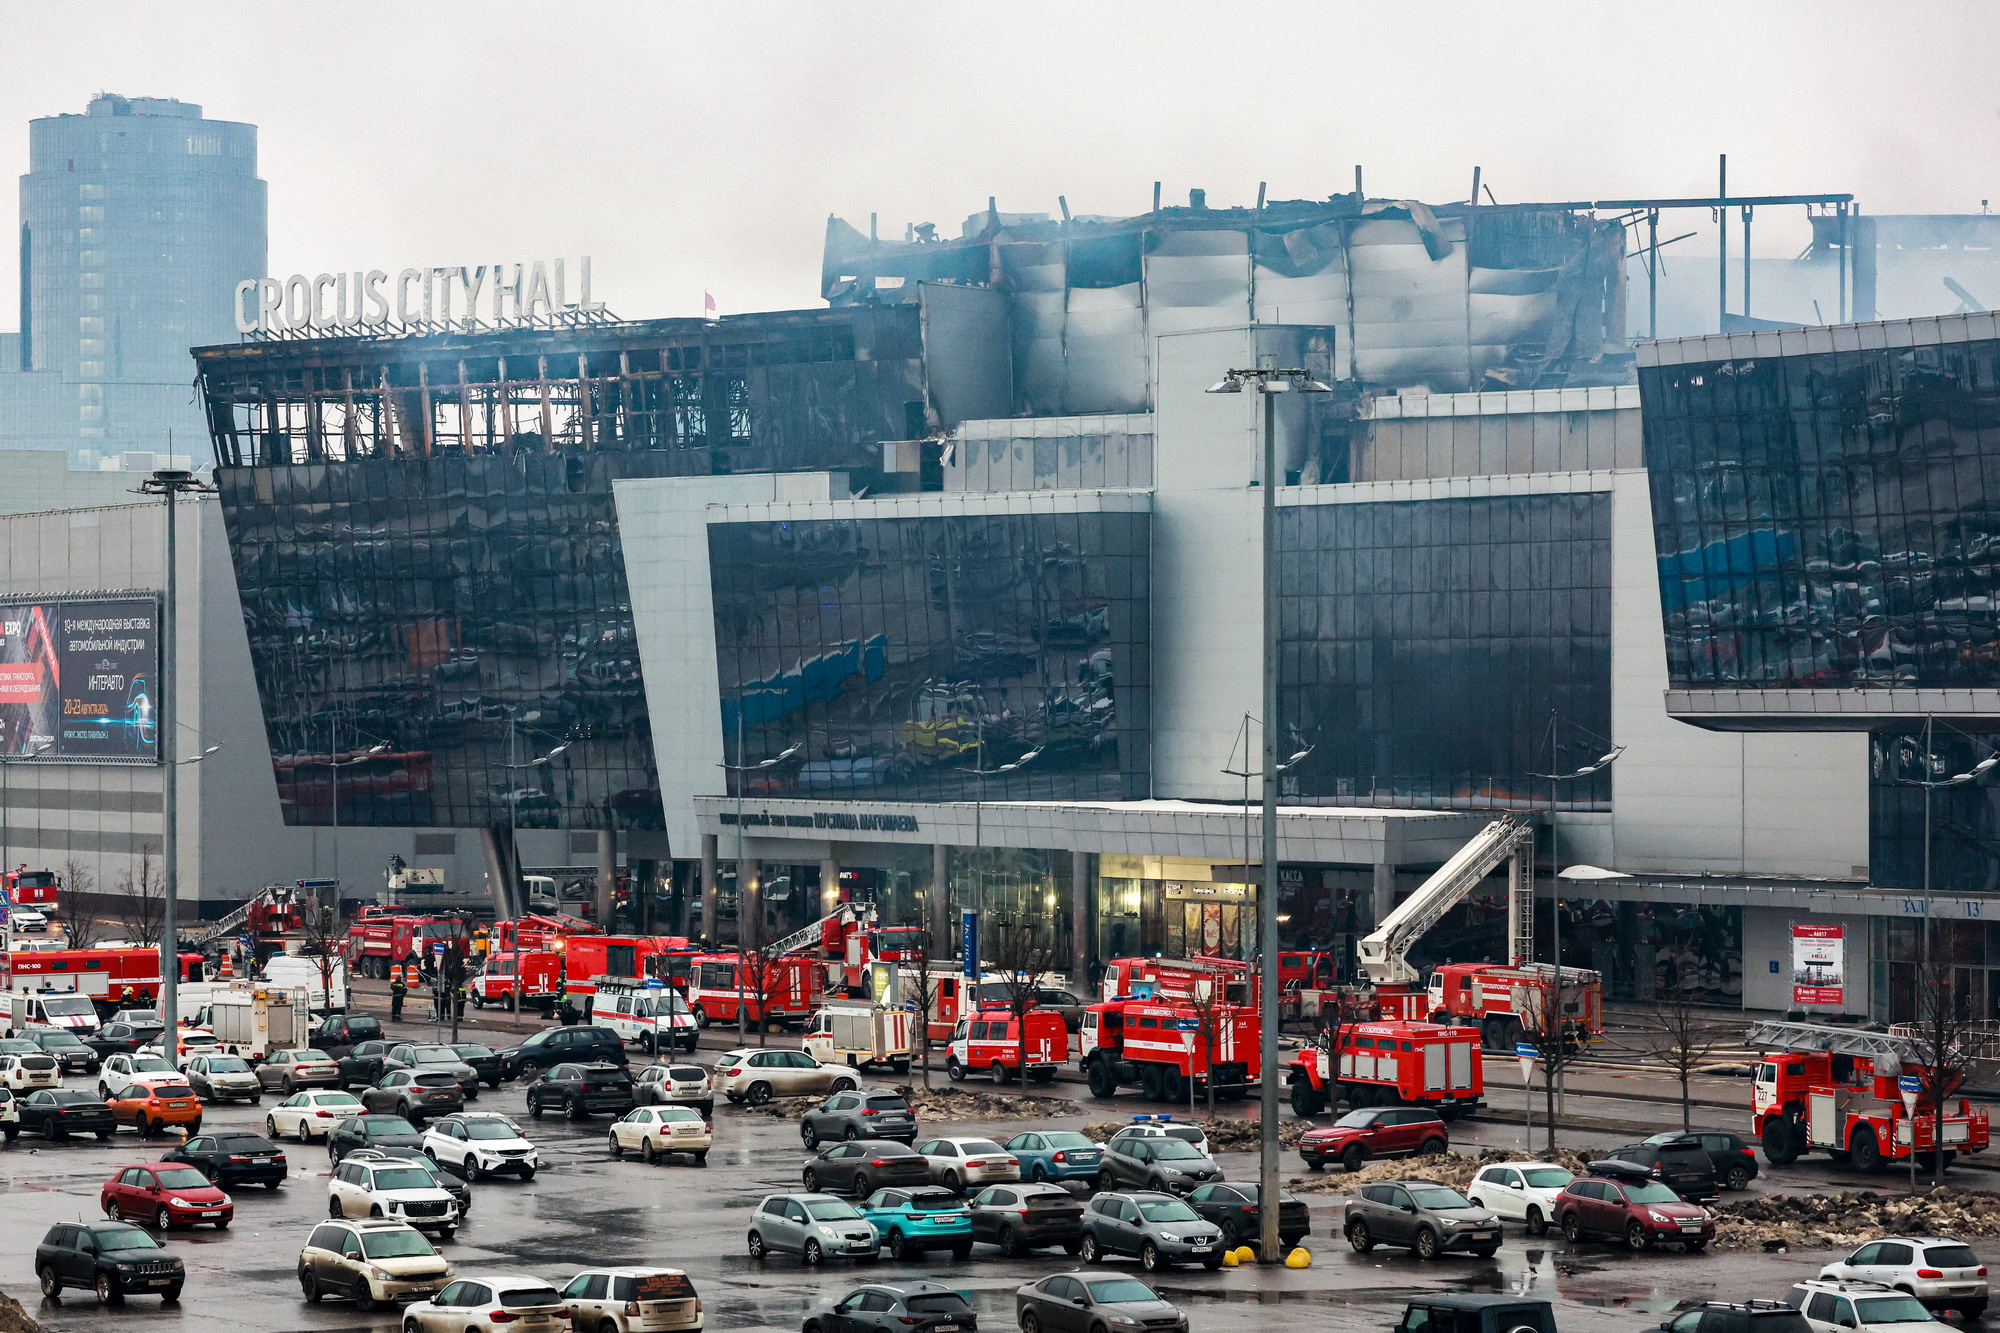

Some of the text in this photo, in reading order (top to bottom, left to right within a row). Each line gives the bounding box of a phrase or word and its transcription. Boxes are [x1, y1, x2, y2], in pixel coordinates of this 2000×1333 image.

[235, 255, 606, 334] CROCUS CITY HALL
[77, 619, 122, 634] международная
[123, 618, 151, 630] выставка
[69, 636, 145, 654] автомобильной индустрии
[88, 675, 124, 690] ИНТЕРАВТО
[64, 699, 80, 714] 20-23
[770, 814, 785, 827] зал
[813, 812, 859, 831] МУСЛИМА
[859, 813, 919, 832] МАГОМАЕВА
[1280, 870, 1303, 882] КАССА
[1903, 900, 1980, 917] ЗАЛ 13
[1758, 1090, 1767, 1101] 227
